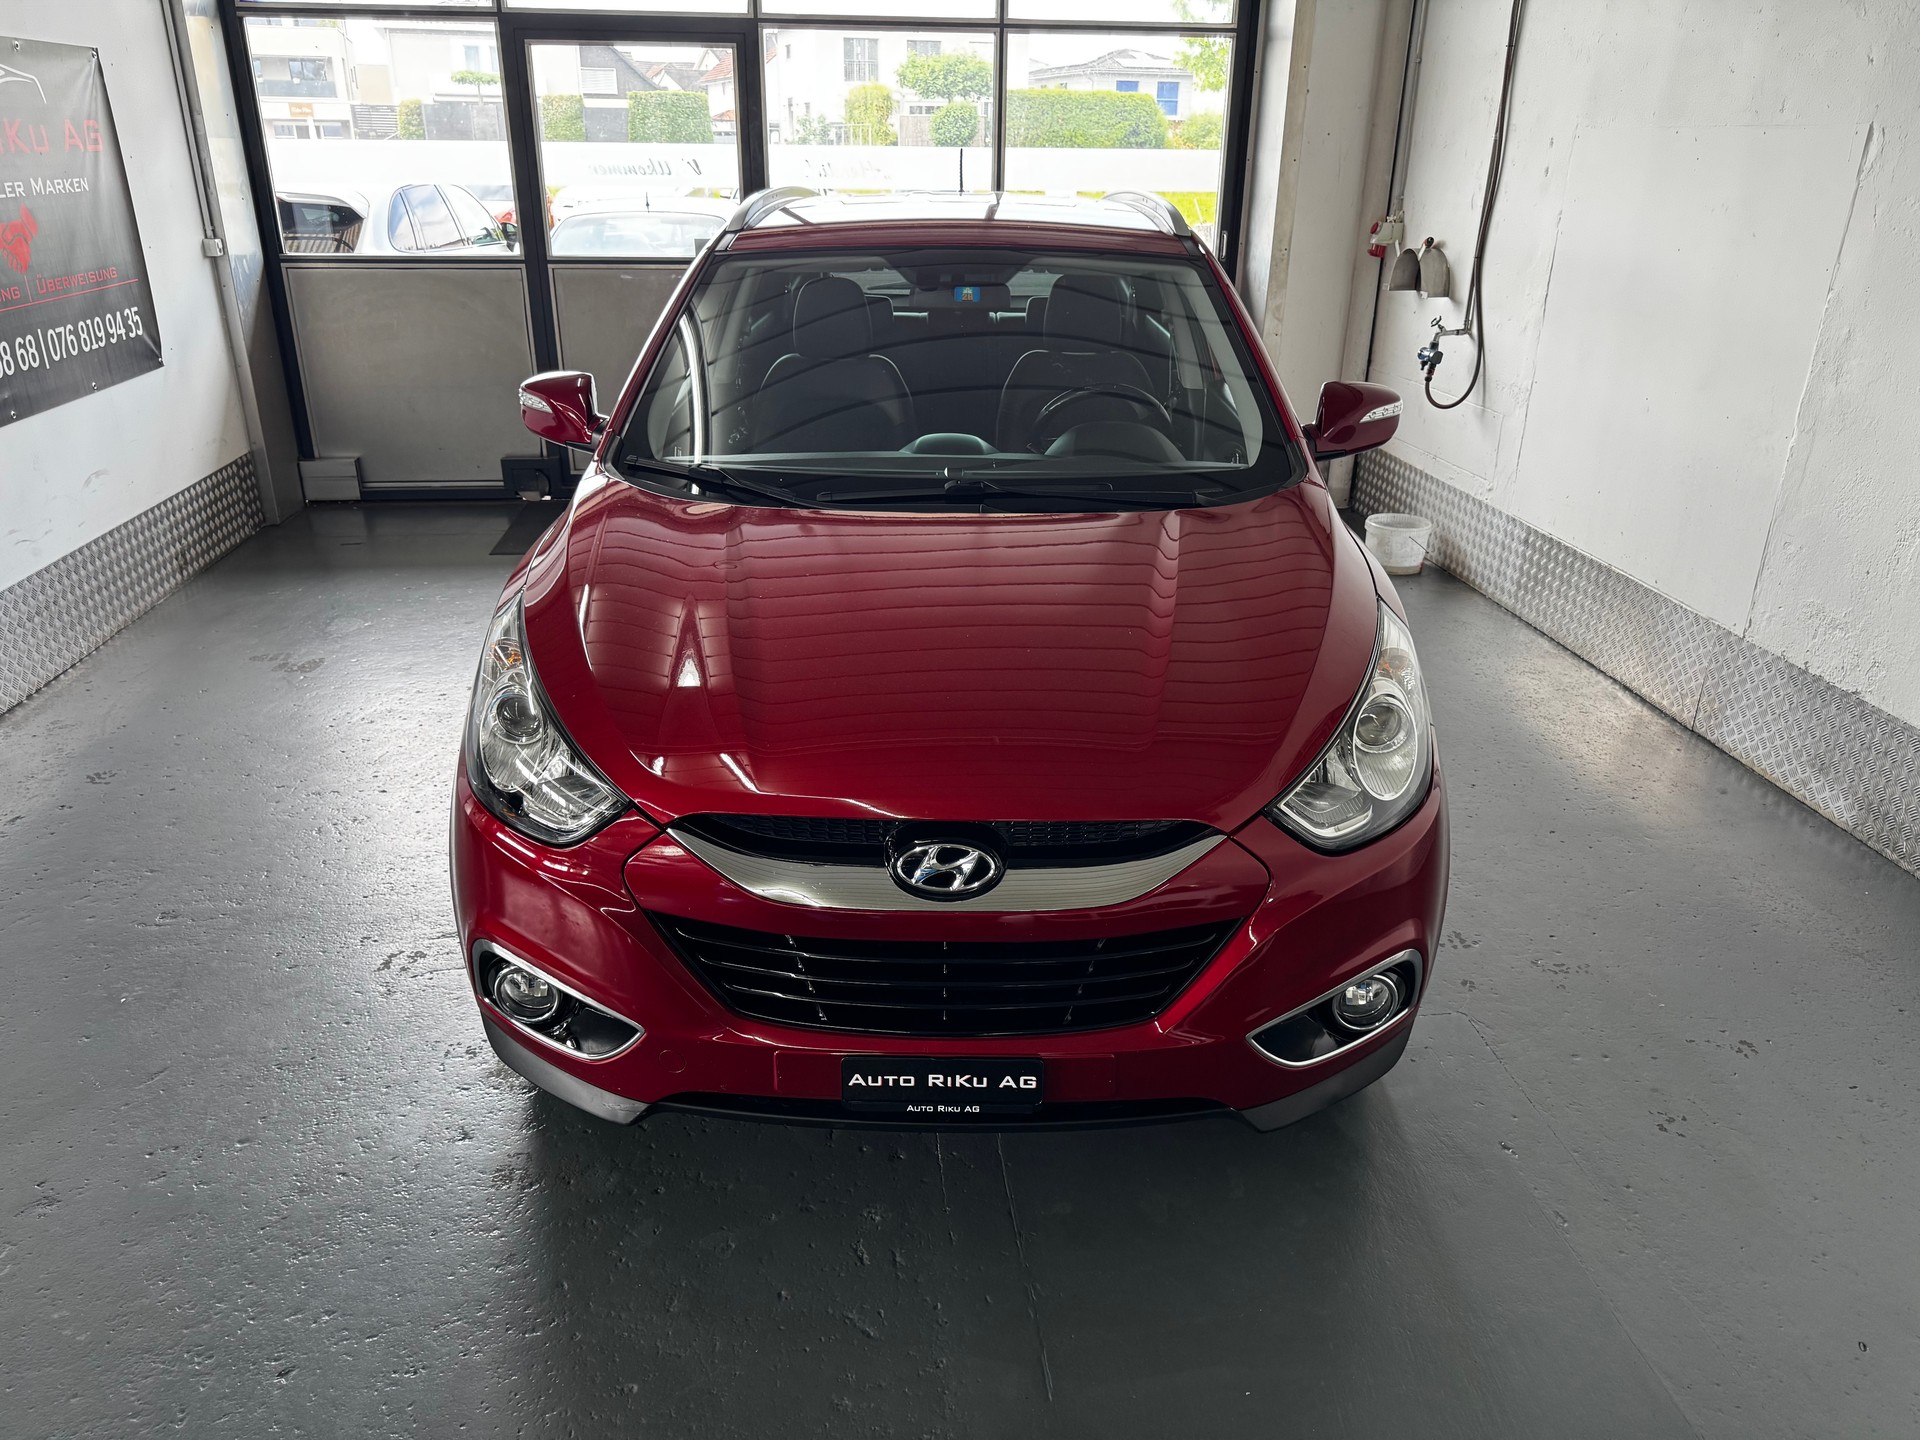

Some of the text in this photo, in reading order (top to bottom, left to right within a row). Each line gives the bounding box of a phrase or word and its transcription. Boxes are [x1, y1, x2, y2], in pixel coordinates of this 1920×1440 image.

[0, 117, 104, 155] KU AG
[30, 177, 89, 196] MARKEN
[0, 266, 118, 302] NG ÜBERWEISUNG
[15, 334, 40, 371] 68
[47, 324, 79, 361] 076
[78, 316, 106, 353] 819
[105, 311, 127, 344] 94
[124, 306, 143, 338] 35
[848, 1073, 915, 1087] AUTO
[998, 1075, 1037, 1089] AG
[906, 1104, 934, 1112] AUTO
[964, 1105, 980, 1113] AG
